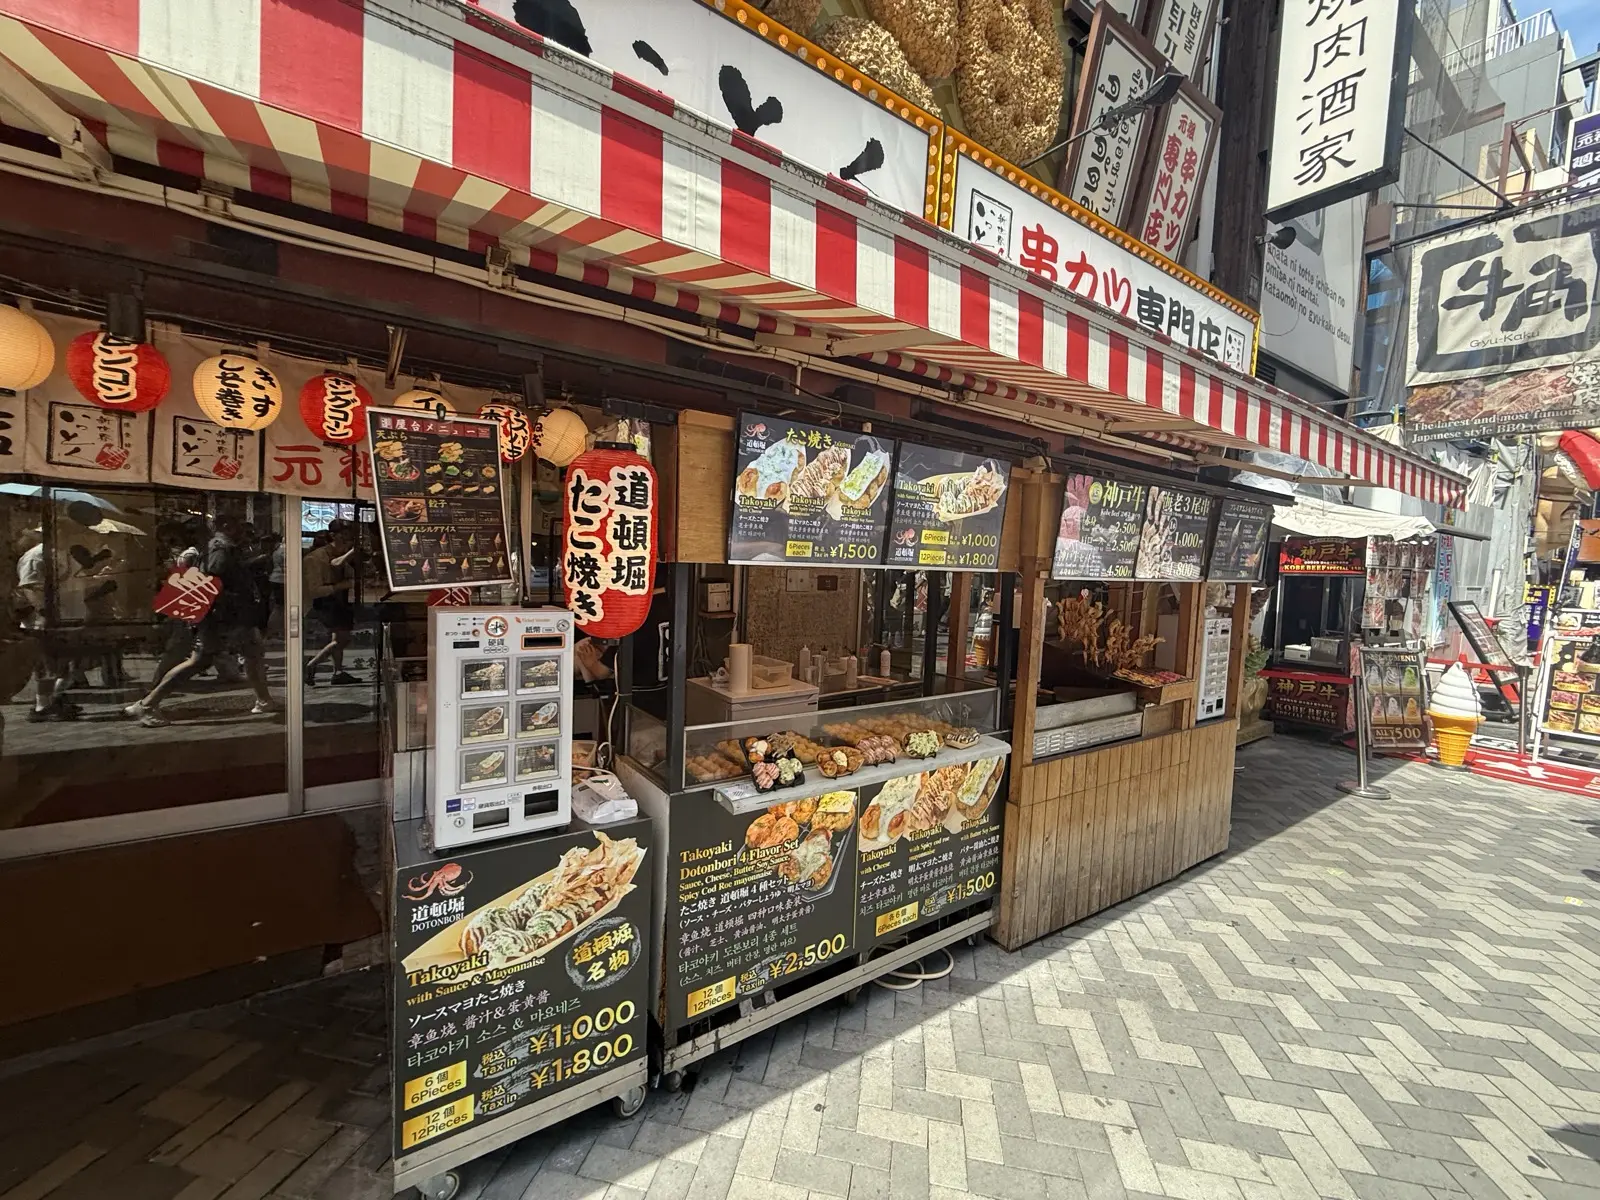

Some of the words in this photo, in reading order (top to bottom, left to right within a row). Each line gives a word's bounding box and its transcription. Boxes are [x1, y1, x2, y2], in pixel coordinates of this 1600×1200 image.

[1266, 261, 1287, 284] omise
[1290, 259, 1298, 272] ni
[1299, 263, 1314, 285] totte
[1338, 295, 1346, 308] no
[1264, 276, 1298, 310] kataomoi
[1299, 302, 1307, 316] no
[1441, 252, 1588, 332] 牛角
[1470, 329, 1540, 348] Gyu-Kaku
[253, 367, 277, 416] きす
[1473, 417, 1496, 425] and
[1500, 411, 1530, 422] most
[1533, 407, 1583, 420] famous
[375, 429, 408, 441] 天ぷら
[785, 427, 833, 450] たこ焼き
[1412, 430, 1462, 443] Japanese
[1464, 425, 1493, 438] style
[899, 480, 934, 494] Takoyaki
[1102, 480, 1145, 511] 神戸牛
[428, 500, 448, 508] 餃子
[739, 496, 777, 508] Takoyaki
[790, 495, 824, 507] Takoyaki
[841, 506, 872, 517] Takoyaki
[611, 471, 650, 590] 道頓堀
[924, 533, 947, 542] 6Pieces
[962, 533, 997, 547] ¥1,000
[567, 474, 602, 621] たこ焼き
[830, 543, 877, 560] ¥1,500
[920, 551, 944, 561] 12Pieces
[1300, 544, 1356, 560] 神戸牛
[959, 552, 995, 566] ¥1,800
[1276, 677, 1339, 699] 神戸牛
[1276, 702, 1305, 715] KOBE
[1308, 707, 1338, 719] BEEF
[909, 825, 942, 842] Takoyaki
[961, 814, 989, 831] Takoyaki
[680, 840, 732, 863] Takoyaki
[680, 853, 737, 881] Dotonbori
[749, 844, 781, 861] Flavor
[783, 838, 800, 851] Set
[860, 844, 897, 863] Takoyaki
[908, 852, 954, 873] 明太マヨたこ焼き
[679, 891, 699, 903] Spicy
[701, 886, 717, 897] Cod
[718, 881, 732, 891] Roe
[734, 870, 772, 887] mayonnaise
[680, 878, 704, 891] Sauce,
[705, 871, 732, 884] Cheese,
[733, 865, 755, 876] Butter
[756, 860, 769, 871] Soy
[859, 868, 903, 891] チーズたこ焼き
[947, 871, 995, 904] ¥1,500
[411, 897, 465, 923] 道頓堀
[680, 898, 717, 917] たこ焼き
[720, 887, 749, 905] 道頓堀
[875, 892, 903, 911] 타코야키
[411, 913, 465, 933] DOTONBORI
[877, 917, 901, 934] 6Pieces
[901, 912, 916, 925] each
[573, 923, 634, 965] 道頓堀
[678, 950, 719, 974] 타코야키
[723, 935, 760, 958] 도톤보리
[763, 929, 778, 943] 4종
[780, 922, 798, 936] 세트
[587, 949, 631, 983] 名物
[726, 957, 742, 969] 버터
[769, 933, 846, 979] ¥2,500
[407, 951, 489, 988] Takoyaki
[740, 969, 758, 982] 税込
[406, 989, 433, 1007] with
[435, 979, 469, 998] Sauce
[485, 956, 546, 983] Mayonnaise
[740, 981, 757, 994] Tax
[408, 979, 526, 1029] ソースマヨたこ焼き
[693, 990, 732, 1013] 12Pieces
[407, 1035, 469, 1068] 타코야키
[477, 1024, 507, 1045] 소스
[512, 1018, 524, 1031] &
[530, 998, 582, 1022] 마요네즈
[530, 1000, 636, 1055] ¥1,000
[481, 1049, 506, 1066] 税込
[531, 1034, 633, 1090] ¥1,800
[481, 1062, 504, 1077] Tax
[411, 1077, 462, 1104] 6Pieces
[481, 1084, 506, 1101] 税込
[481, 1098, 504, 1114] Tax
[411, 1112, 468, 1143] 12Pieces
